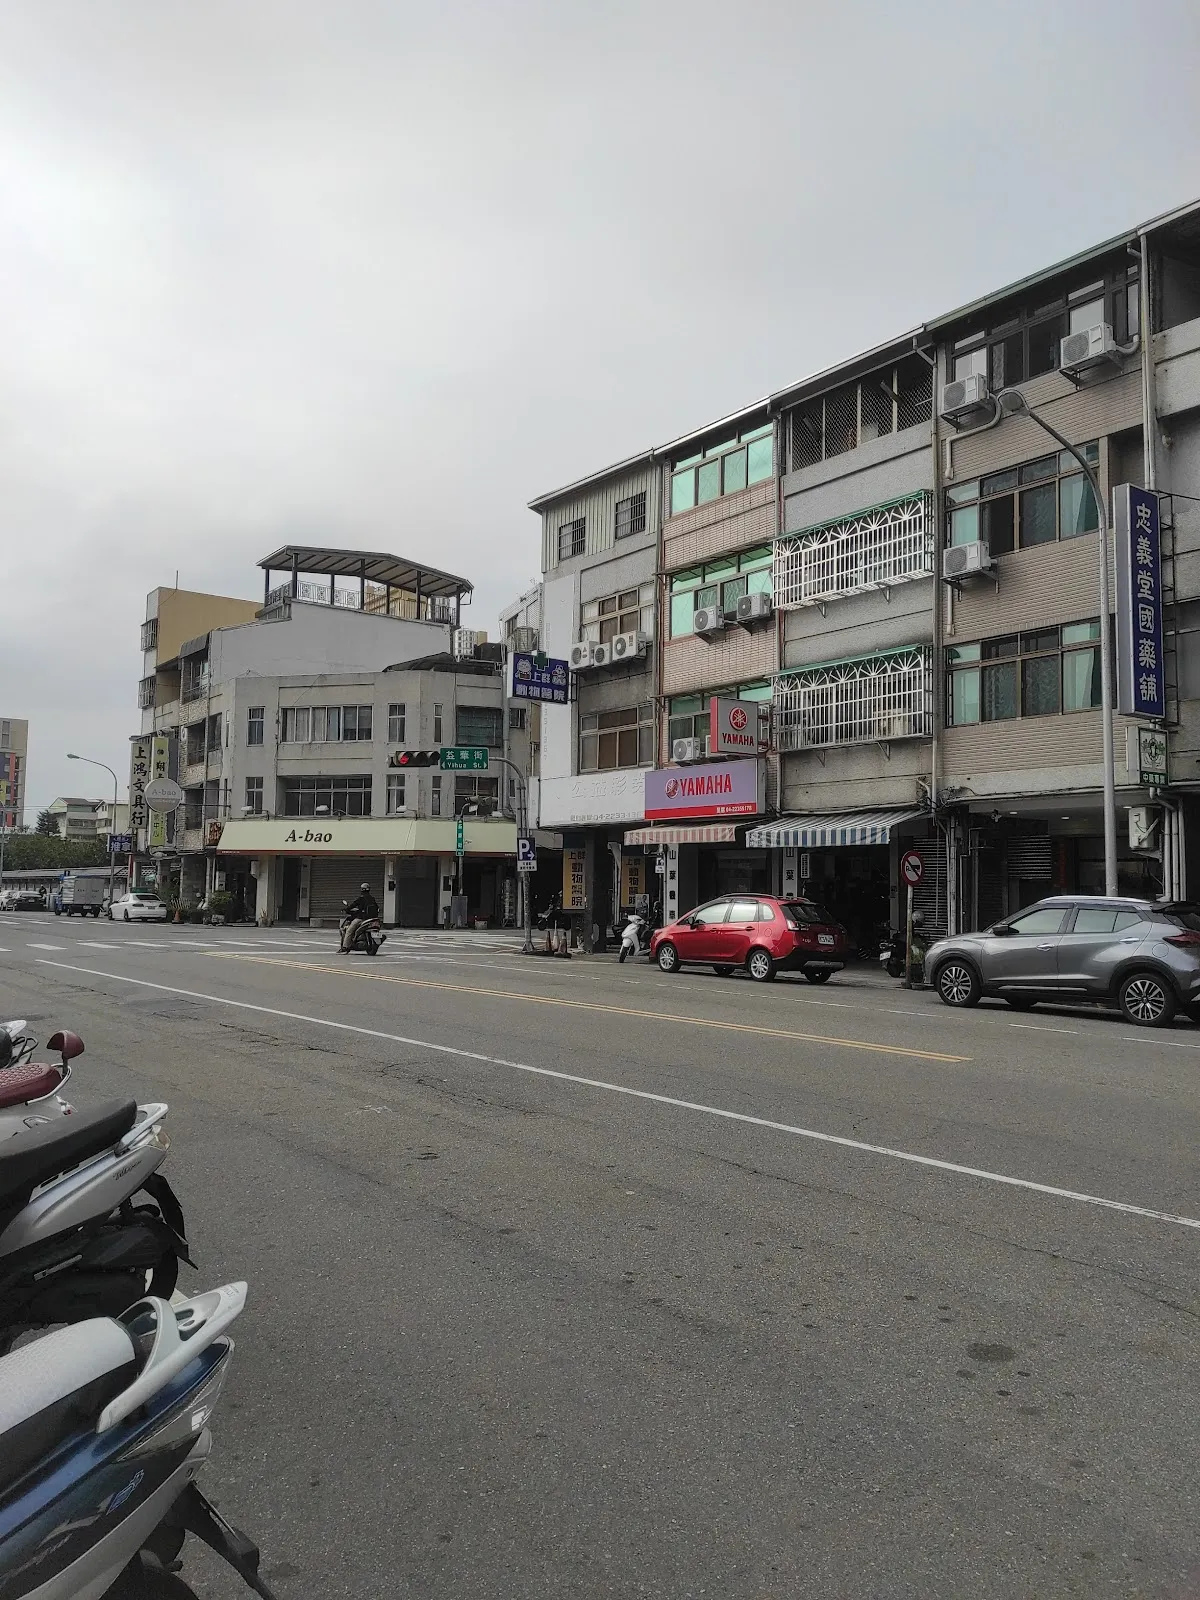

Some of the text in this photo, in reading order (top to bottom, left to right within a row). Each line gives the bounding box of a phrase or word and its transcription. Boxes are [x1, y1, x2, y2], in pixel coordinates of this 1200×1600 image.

[515, 684, 565, 701] 動物醫院
[722, 732, 755, 746] YAMAHA
[131, 746, 147, 825] 上鴻文具行
[151, 788, 177, 796] A-bao
[680, 774, 732, 797] YAMAHA
[285, 829, 333, 843] A-bao
[519, 839, 530, 860] P
